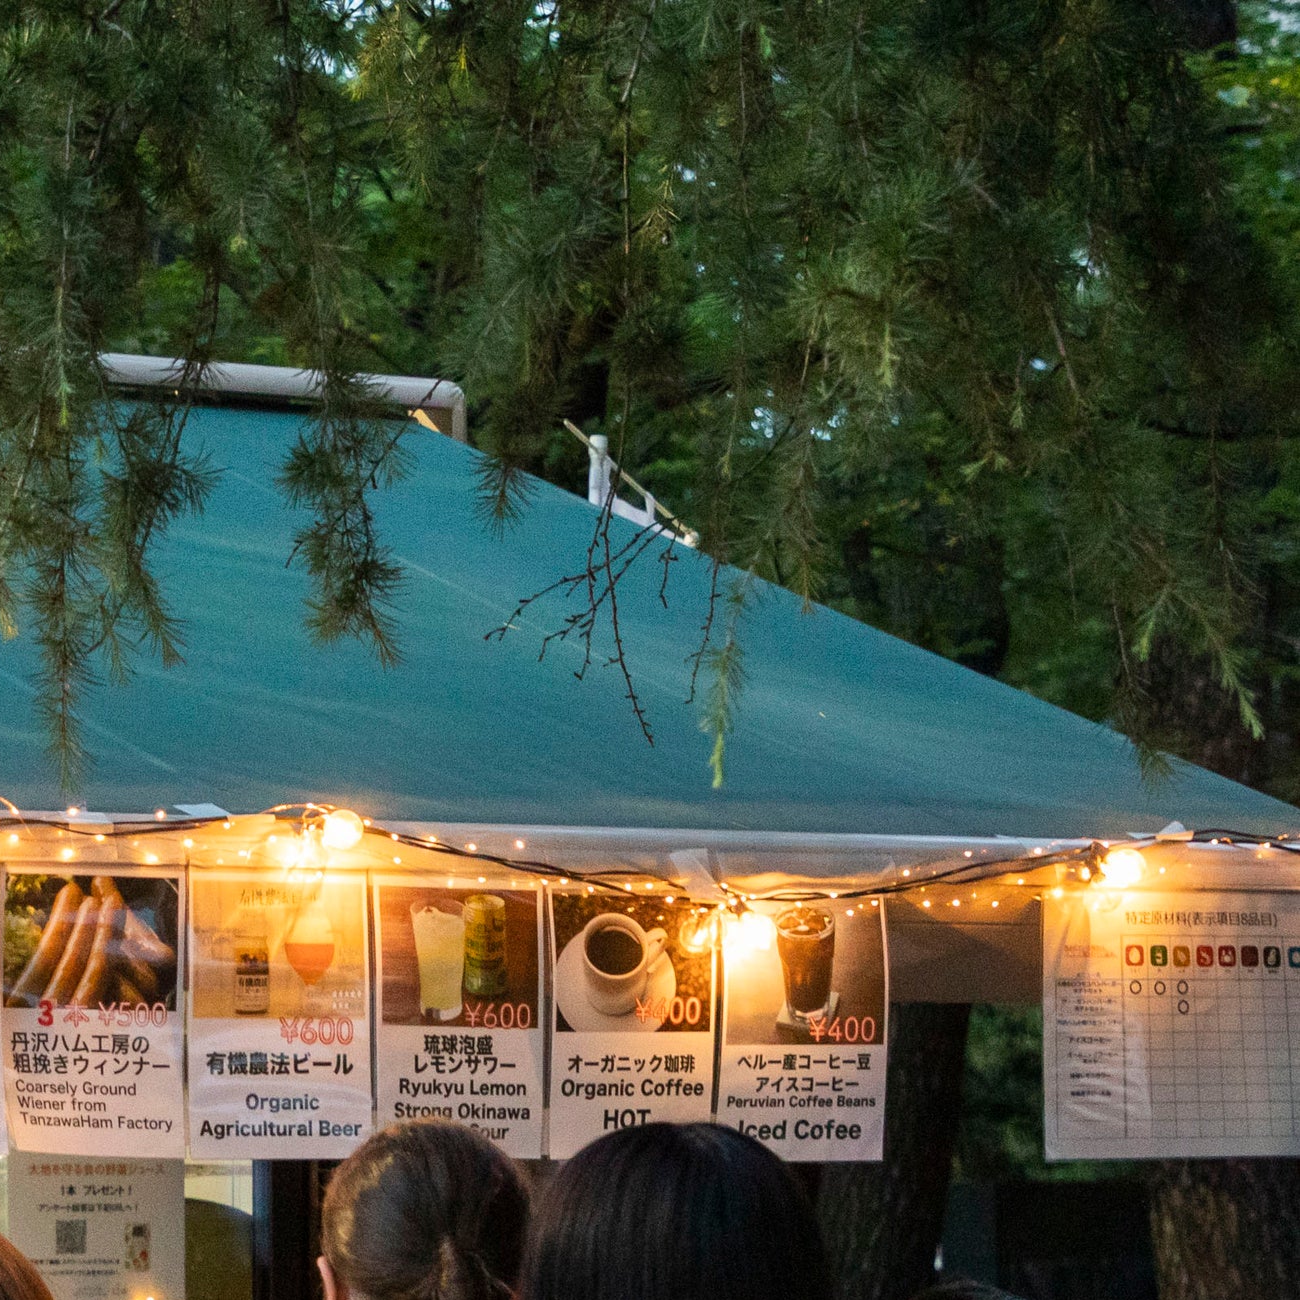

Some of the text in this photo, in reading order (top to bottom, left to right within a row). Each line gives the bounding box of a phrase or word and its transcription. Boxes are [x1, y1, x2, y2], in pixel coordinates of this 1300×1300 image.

[38, 1000, 168, 1028] 3 本 ¥500
[465, 1002, 531, 1029] ¥600
[635, 997, 701, 1025] ¥400
[279, 1016, 354, 1045] ¥600
[809, 1016, 875, 1042] ¥400
[11, 1032, 150, 1054] 丹沢ハム工房の
[423, 1034, 493, 1055] 琉球泡盛
[13, 1053, 170, 1075] 粗挽きウィンナー
[206, 1052, 354, 1075] 有機農法ビール
[414, 1055, 516, 1075] レモンサワー
[568, 1054, 695, 1073] オーガニック珈琲
[738, 1053, 871, 1070] ペルー産コーヒー豆
[15, 1079, 137, 1096] Coarsely Ground
[399, 1078, 527, 1098] Ryukyu Lemon
[561, 1078, 704, 1100] Organic Coffee
[755, 1077, 859, 1092] アイスコーヒー
[17, 1096, 107, 1112] Wiener from
[245, 1094, 320, 1113] Organic
[394, 1102, 531, 1120] Strong Okinawa
[727, 1096, 876, 1107] Peruvian Coffee Beans
[20, 1112, 173, 1133] TanzawaHam Factory
[200, 1120, 363, 1140] Agricultural Beer
[603, 1109, 651, 1130] HOT
[739, 1119, 861, 1140] Iced Cofee
